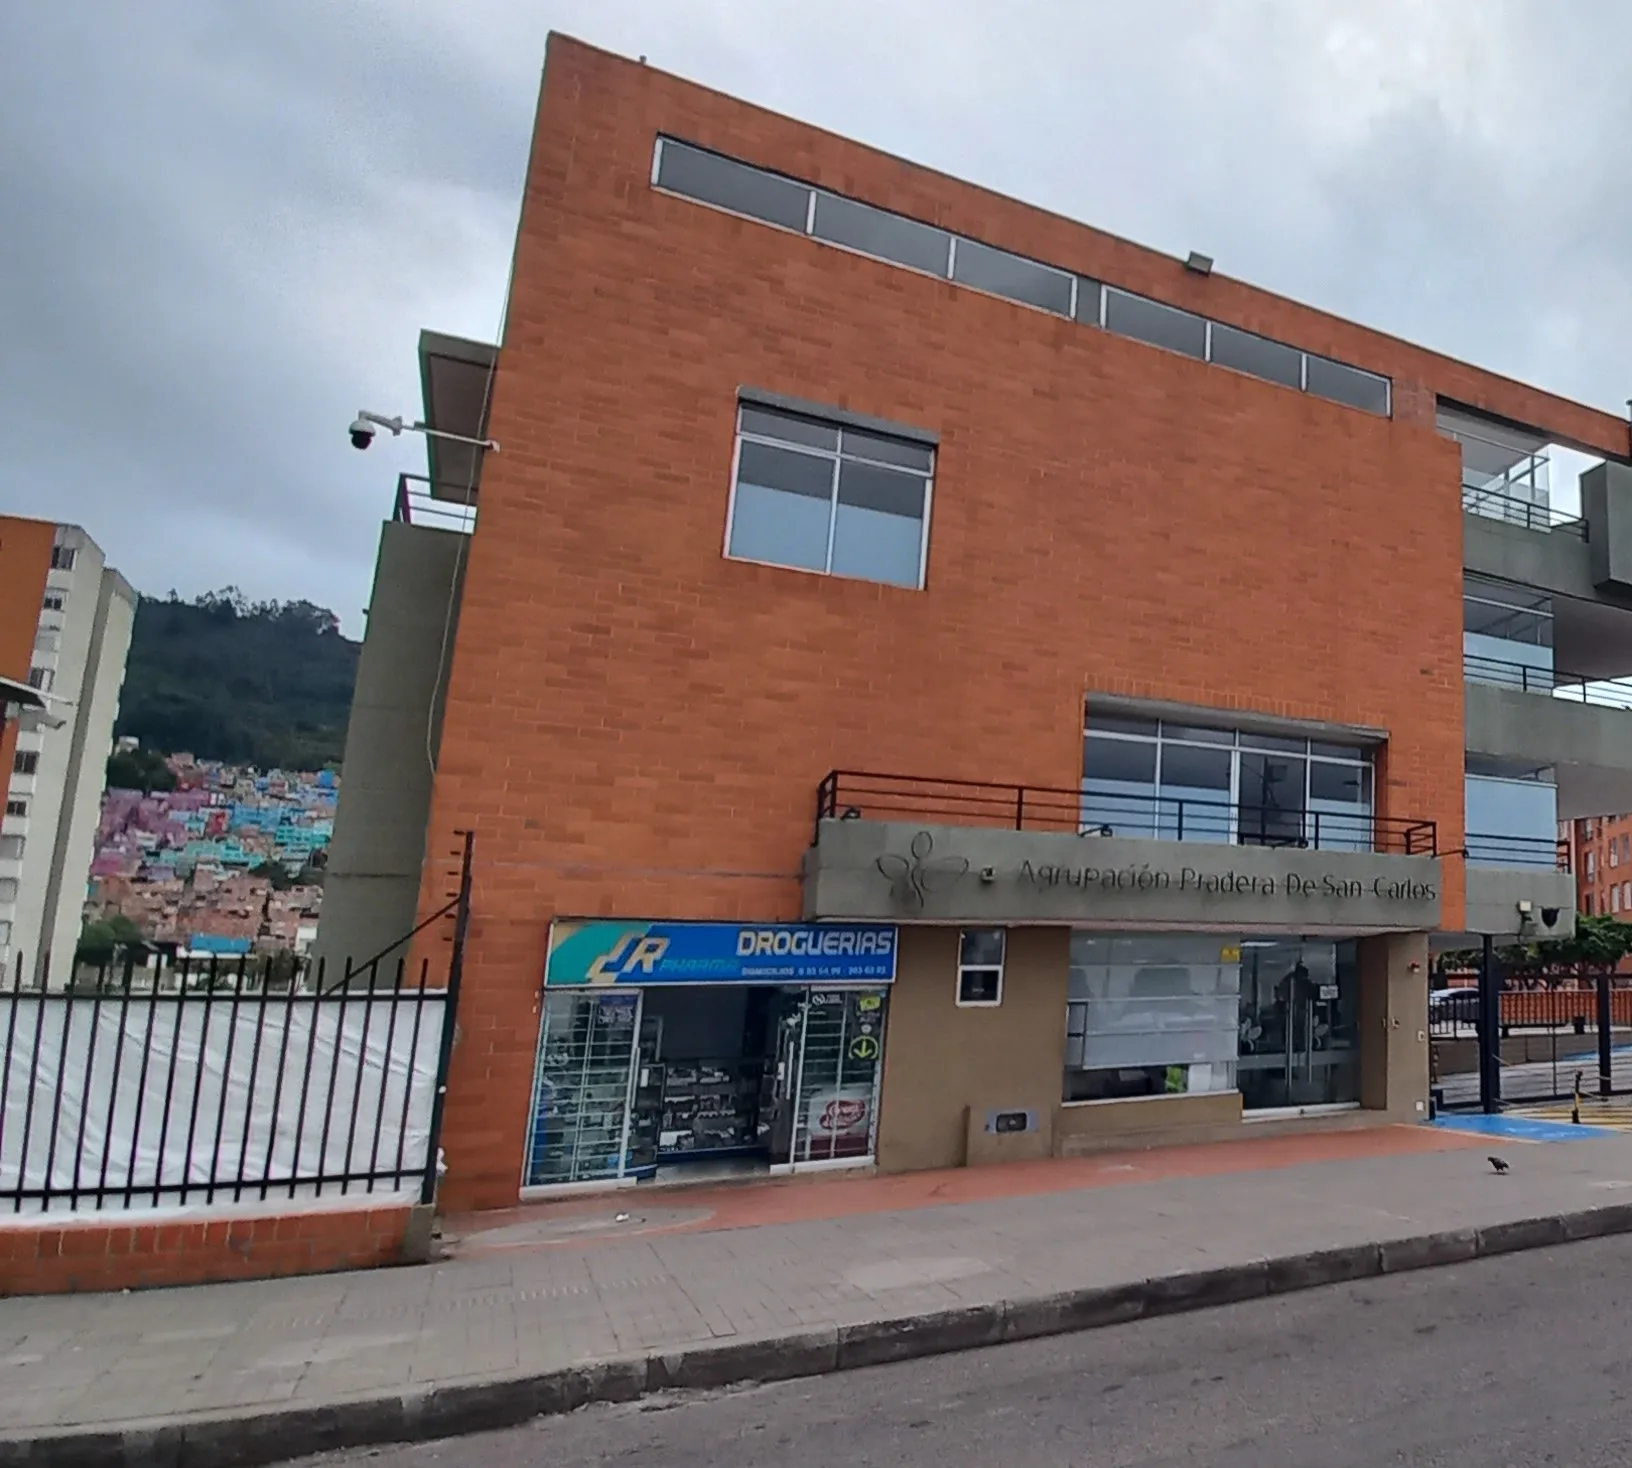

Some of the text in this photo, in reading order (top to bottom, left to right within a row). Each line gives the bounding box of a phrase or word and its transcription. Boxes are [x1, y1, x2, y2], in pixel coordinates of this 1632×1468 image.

[1018, 859, 1437, 901] Agrupación Pradera De San Carlos
[736, 930, 893, 957] DROGUERIAS
